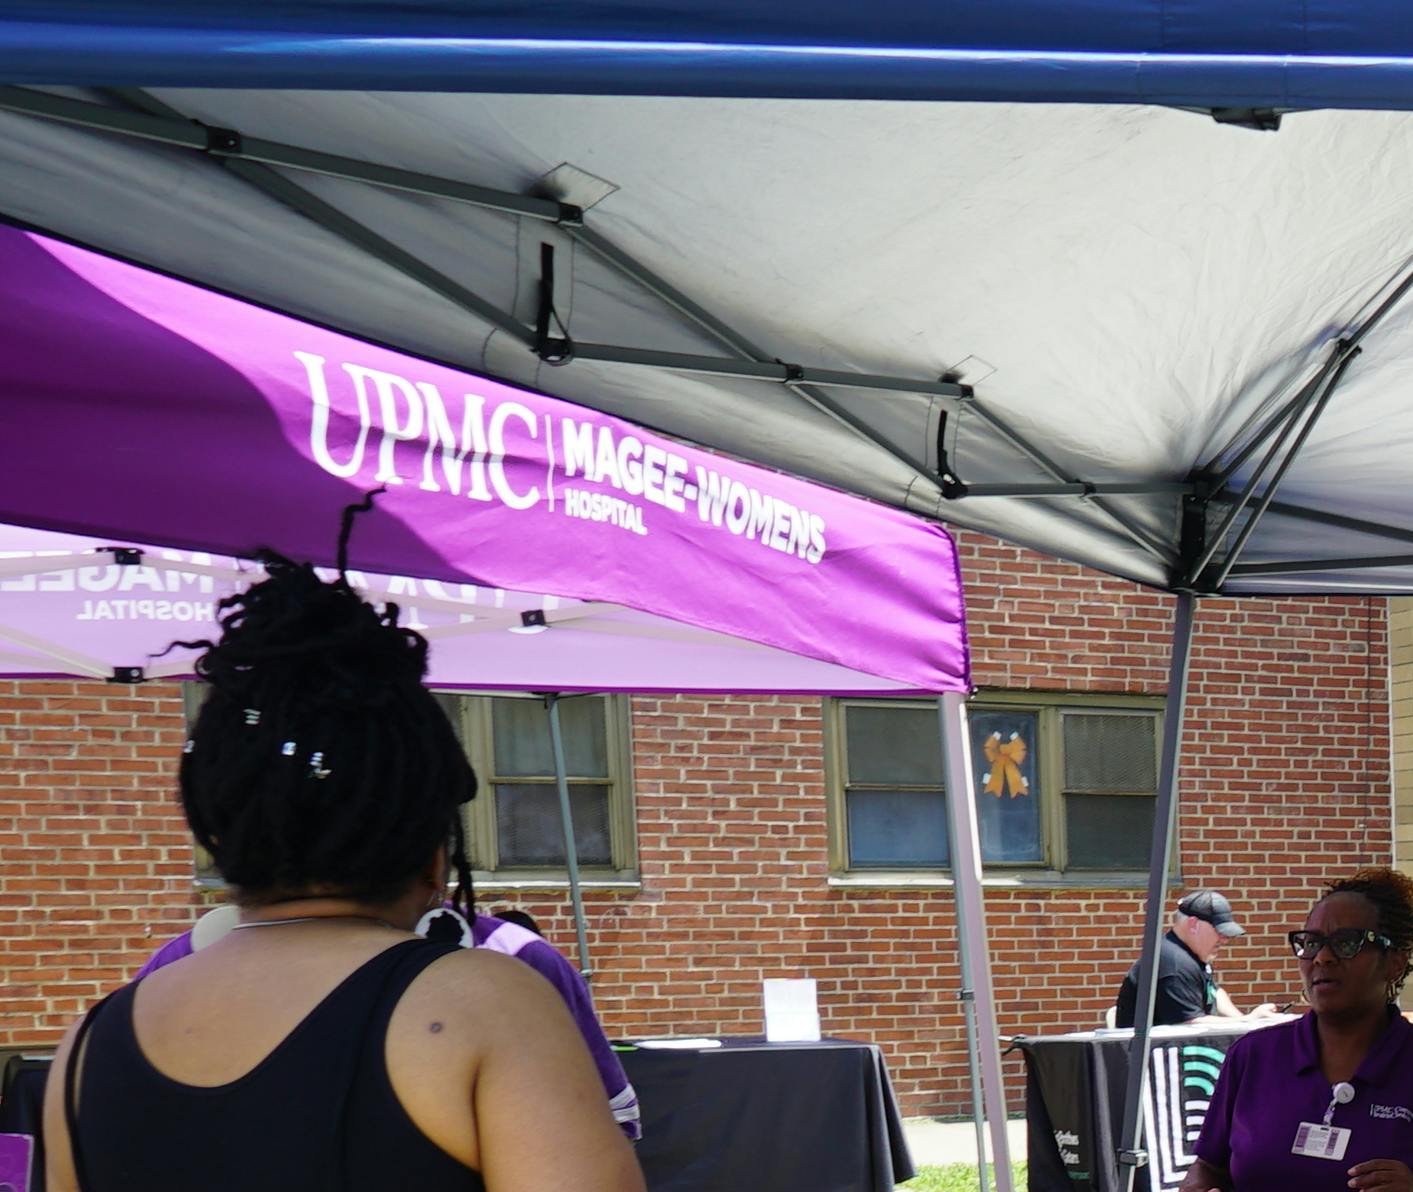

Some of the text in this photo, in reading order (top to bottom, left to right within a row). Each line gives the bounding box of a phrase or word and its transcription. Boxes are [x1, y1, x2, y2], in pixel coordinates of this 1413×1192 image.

[293, 350, 541, 510] UPMC
[562, 416, 827, 565] MAGEE-WOMENS
[564, 488, 648, 536] HOSPITAL
